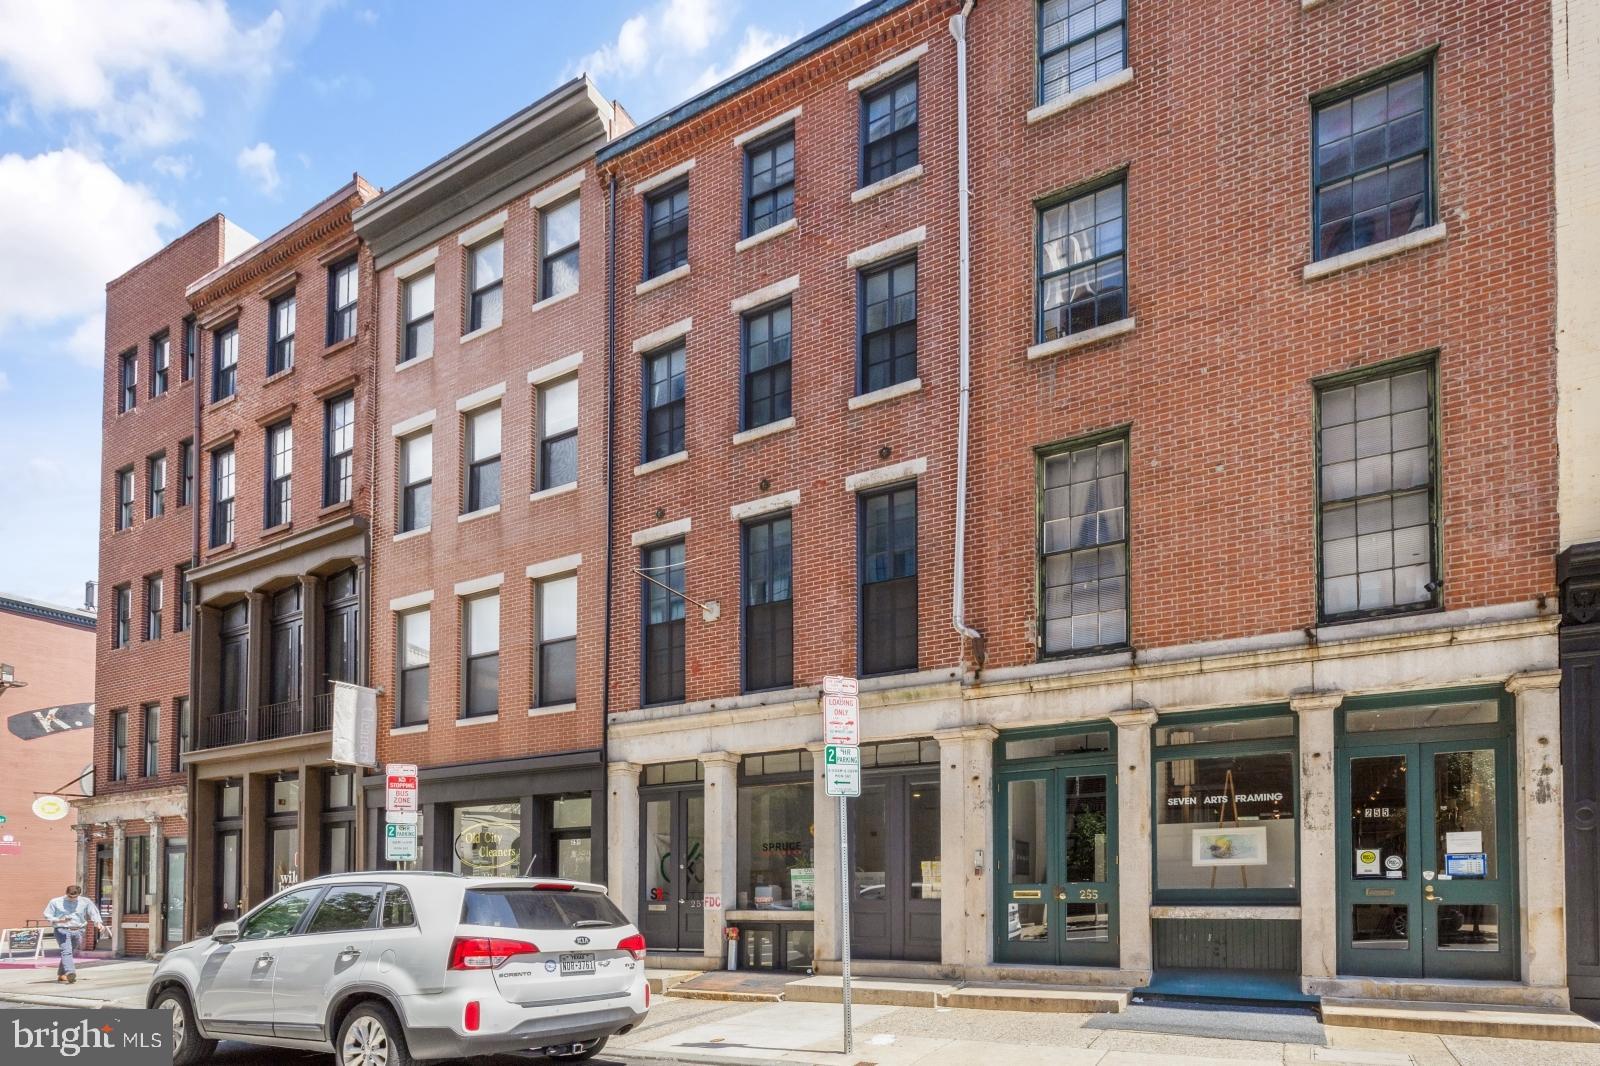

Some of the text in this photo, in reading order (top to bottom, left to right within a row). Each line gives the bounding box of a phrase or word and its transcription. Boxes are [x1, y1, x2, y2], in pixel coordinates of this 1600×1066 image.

[828, 749, 835, 762] 2
[1168, 793, 1283, 806] SEVEN ARTS FRAMING
[1365, 808, 1389, 817] 255
[388, 827, 395, 836] 2
[465, 831, 503, 845] Old City
[480, 845, 516, 857] Cleaners
[762, 841, 801, 852] SPRUCE
[1080, 890, 1098, 900] 255
[690, 900, 704, 908] 25
[705, 897, 720, 907] FDC
